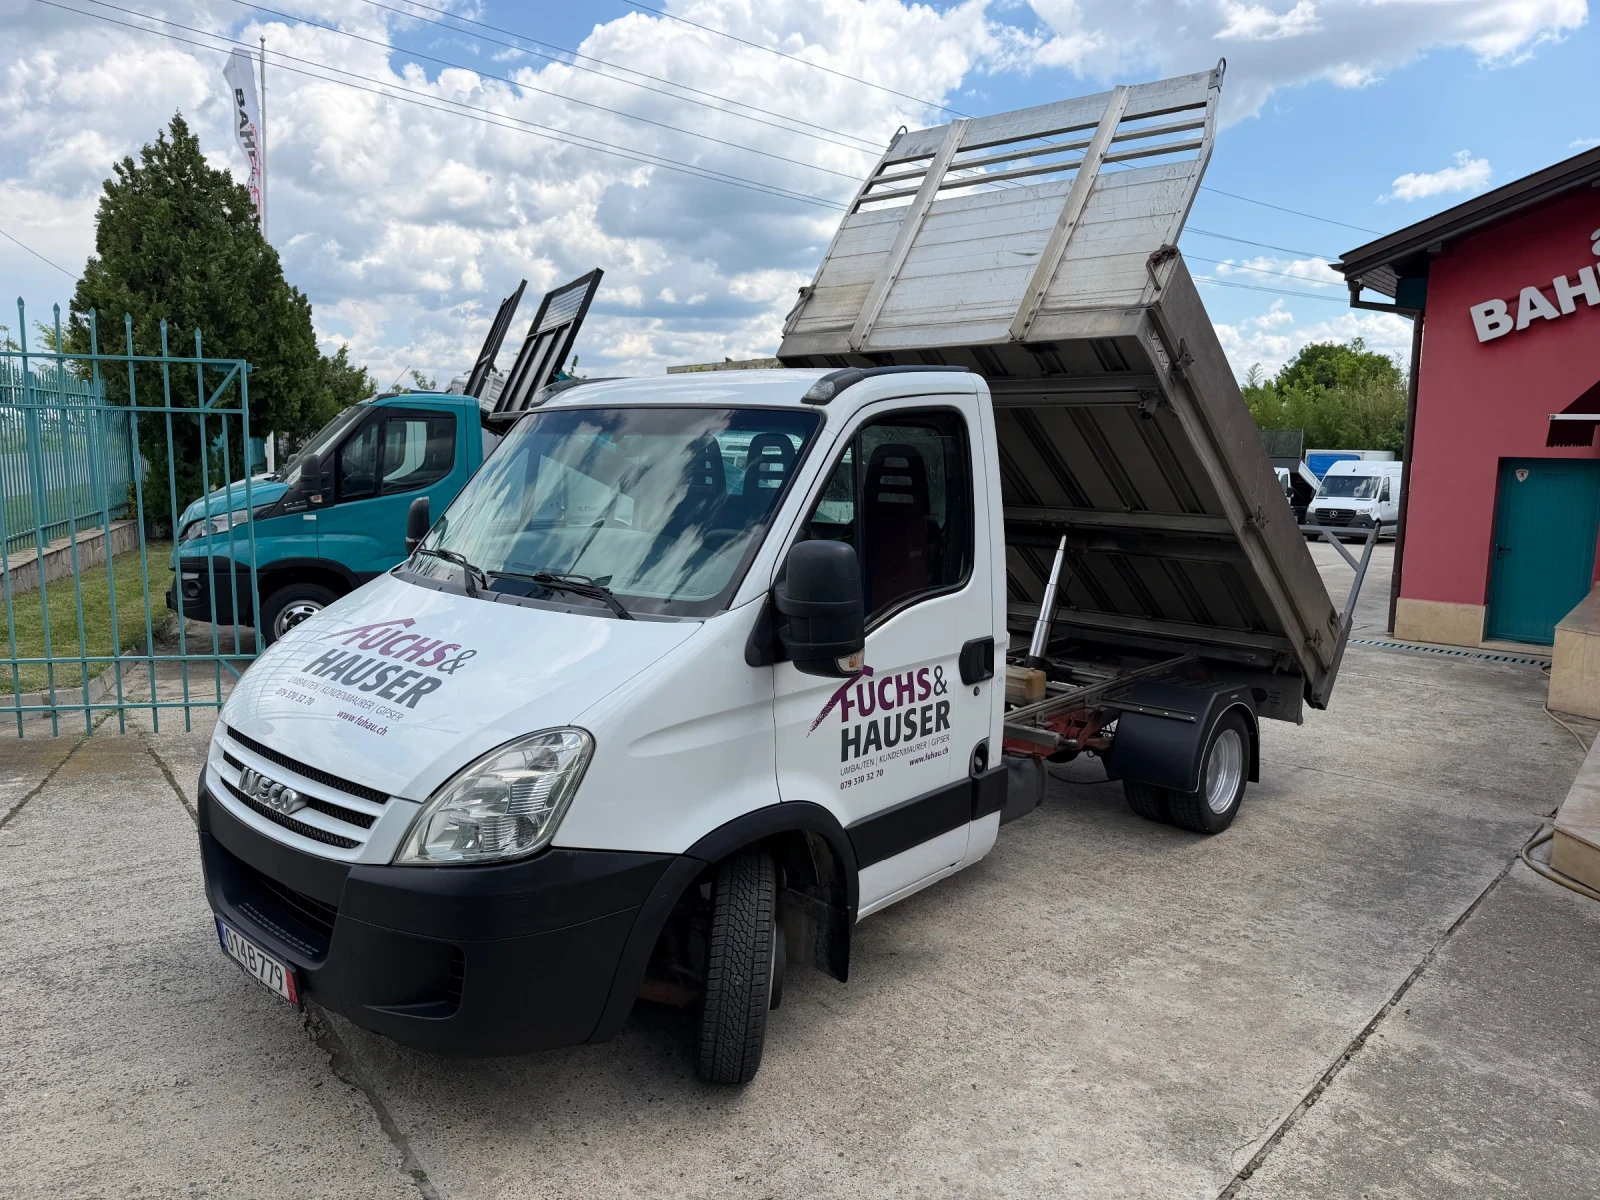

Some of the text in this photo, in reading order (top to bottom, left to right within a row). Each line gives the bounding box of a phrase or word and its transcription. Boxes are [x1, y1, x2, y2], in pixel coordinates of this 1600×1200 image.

[288, 676, 321, 691] UMBAUTEN
[320, 686, 375, 710] KUNDENMAURER
[376, 706, 404, 722] GIPSER
[302, 649, 443, 709] HAUSER
[304, 697, 315, 706] 70
[337, 711, 389, 736] www.fuhau.ch
[841, 700, 951, 762] HAUSER
[840, 757, 875, 776] UMBAUTEN
[879, 741, 928, 763] KUNDENMAURER
[931, 734, 950, 746] GIPSER
[909, 746, 949, 766] www.fuhau.ch
[238, 766, 303, 815] IVECO
[840, 779, 852, 790] 079
[866, 772, 874, 781] 32
[875, 768, 884, 778] 70
[225, 927, 283, 992] 014B779
